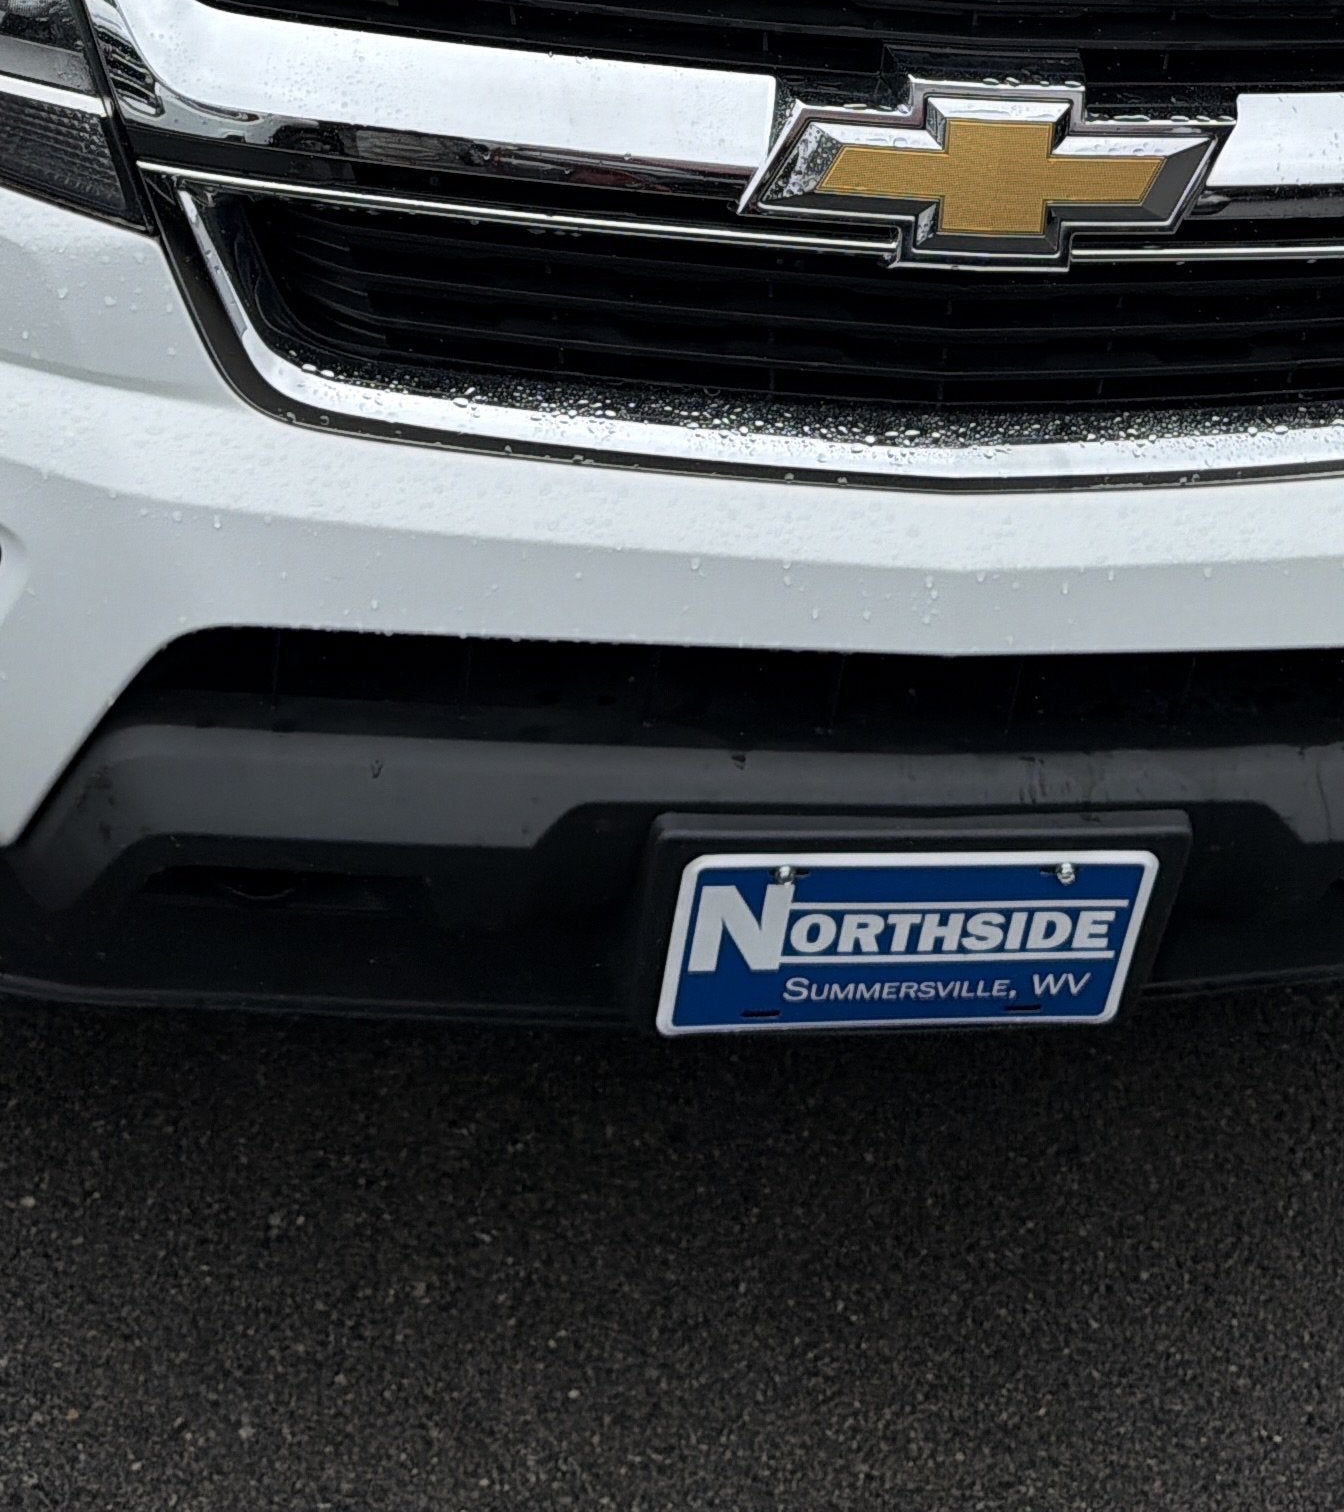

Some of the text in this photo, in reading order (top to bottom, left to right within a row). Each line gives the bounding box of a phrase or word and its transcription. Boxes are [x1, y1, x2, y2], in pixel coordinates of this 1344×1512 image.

[688, 884, 1117, 973] NORTHSIDE
[782, 972, 1092, 1002] SUMMERSVILLE, WV
